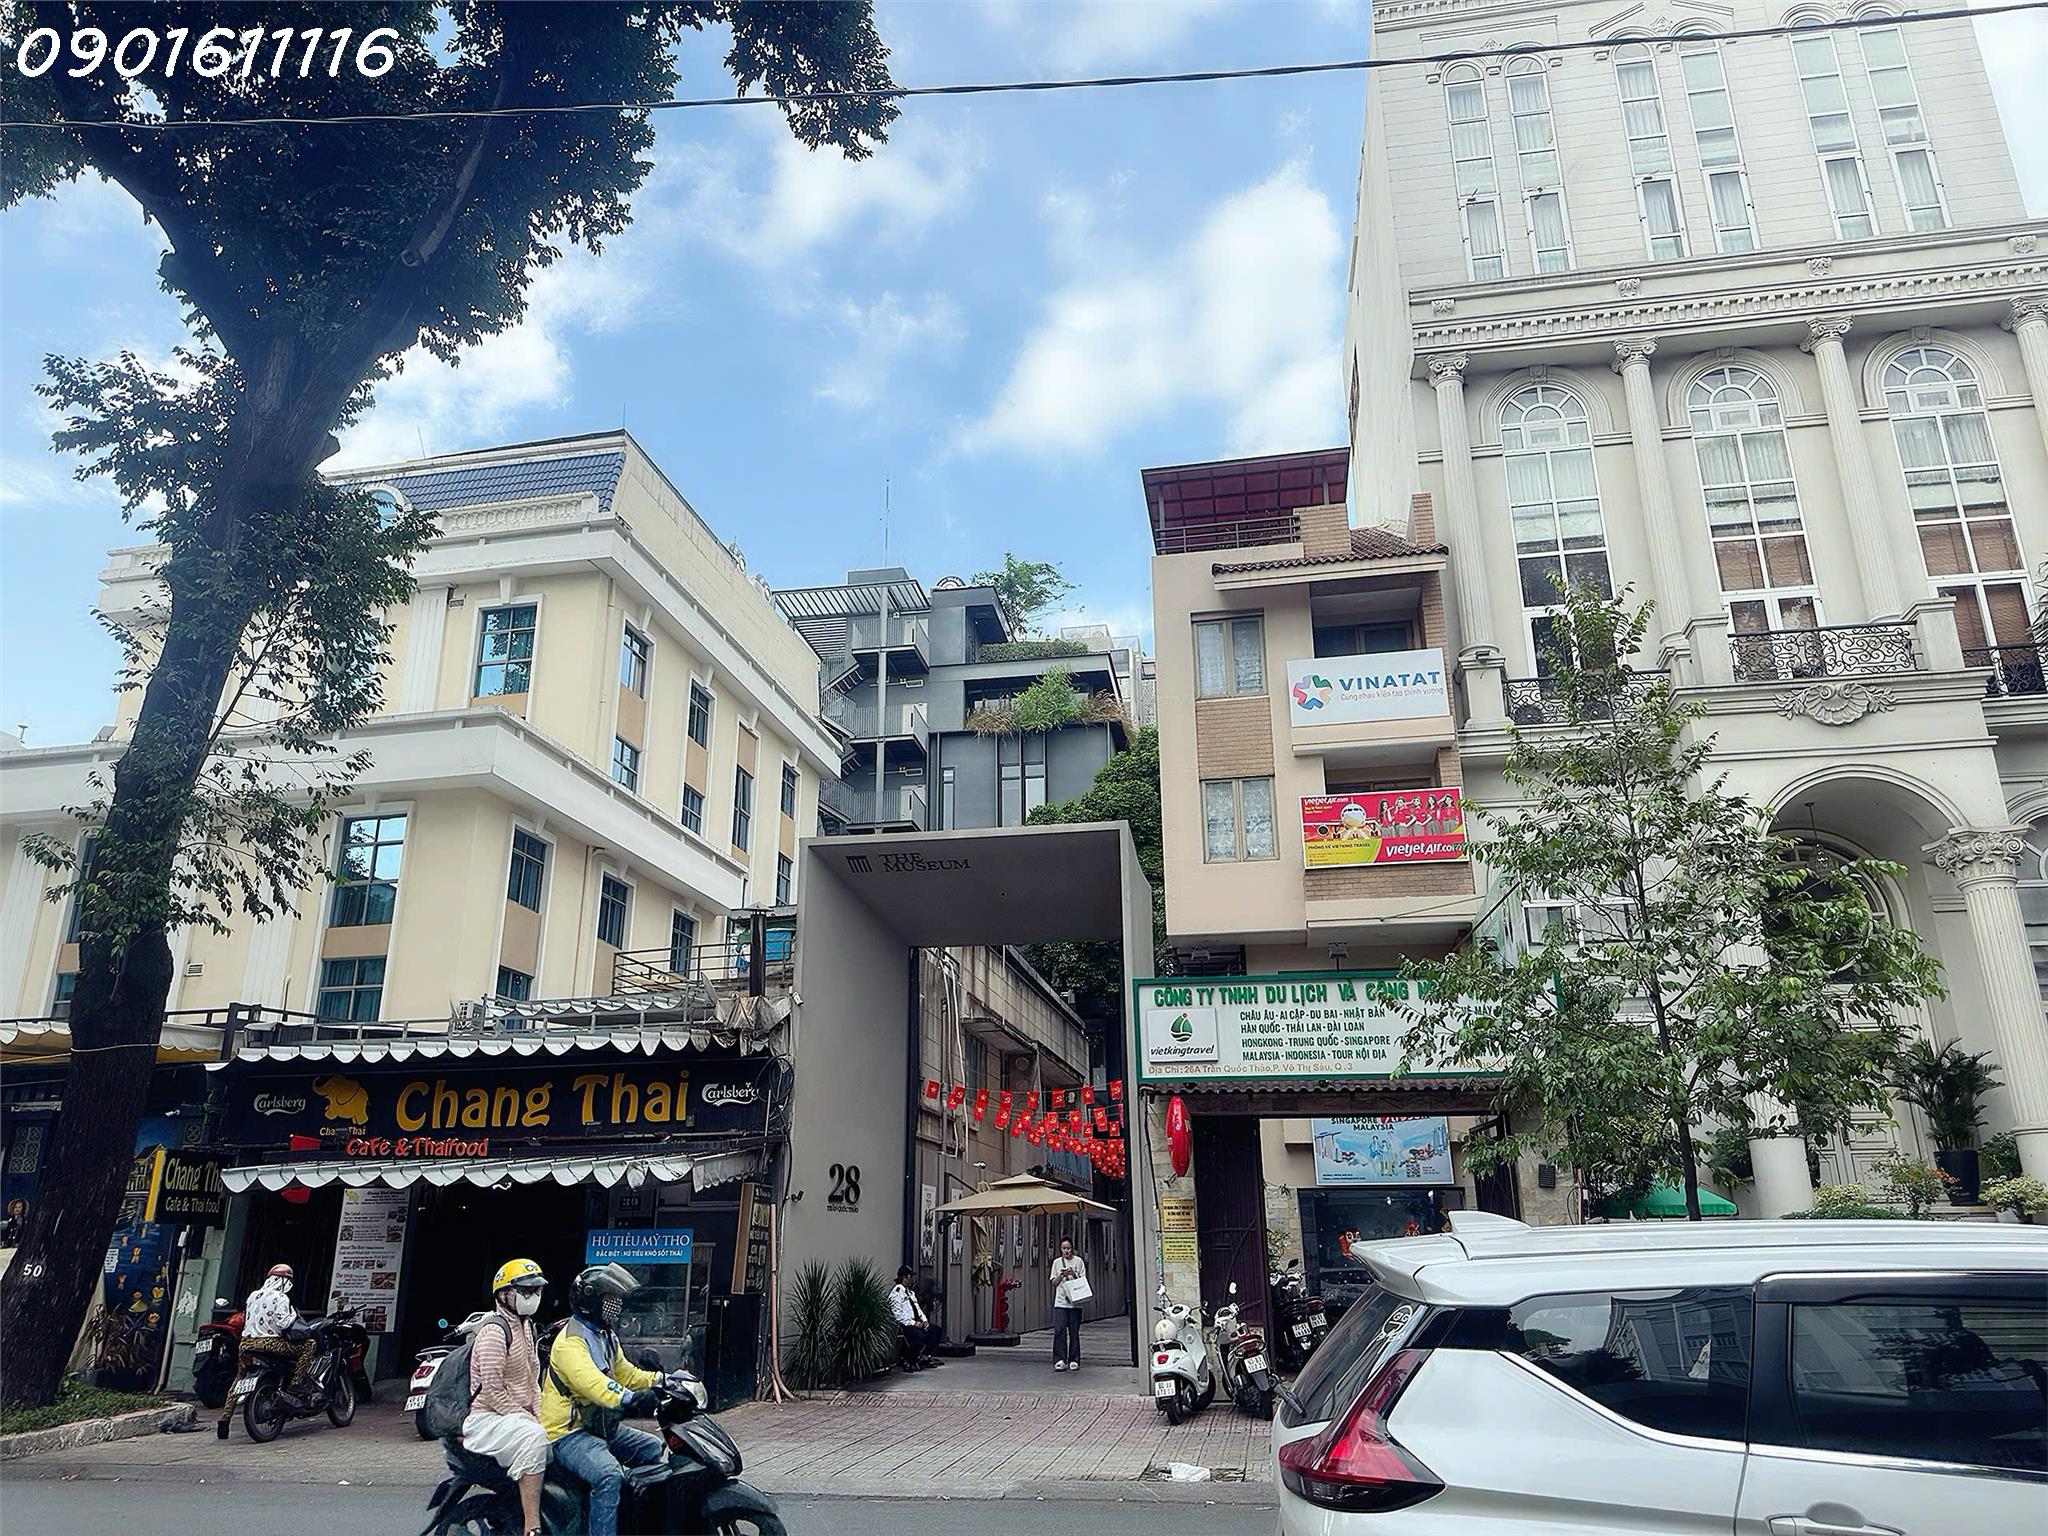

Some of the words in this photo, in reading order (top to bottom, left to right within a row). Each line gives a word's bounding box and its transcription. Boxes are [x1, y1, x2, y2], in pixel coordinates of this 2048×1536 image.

[1338, 671, 1440, 691] VINATAT
[1340, 692, 1358, 701] Cùng
[878, 852, 922, 864] THE
[884, 858, 971, 873] MUSEUM
[1153, 986, 1193, 1007] CÔNG
[1197, 987, 1215, 1006] TY
[1219, 986, 1259, 1005] TNHH
[1265, 985, 1287, 1004] DU
[1292, 984, 1328, 1008] LỊCH
[1337, 978, 1358, 1002] VÀ
[1240, 1009, 1261, 1021] CHÂU
[1264, 1009, 1275, 1020] ÂU
[1280, 1010, 1288, 1020] AI
[1289, 1009, 1305, 1021] CẬP
[1310, 1010, 1321, 1019] DU
[1324, 1009, 1337, 1019] BAI
[1343, 1008, 1365, 1020] NHẬT
[1368, 1006, 1386, 1018] BẢN
[1241, 1022, 1257, 1034] HÀN
[1258, 1020, 1281, 1034] QUỐC
[1286, 1021, 1304, 1033] THÁI
[1307, 1022, 1322, 1033] LAN
[1327, 1020, 1341, 1032] ĐÀI
[1344, 1021, 1365, 1031] LOAN
[1242, 1037, 1283, 1048] HONGKONG
[1316, 1033, 1339, 1046] QUỐC
[1150, 1045, 1215, 1058] vietkingtravel
[1243, 1051, 1280, 1061] MALAYSIA
[1285, 1050, 1326, 1060] INDONESIA
[1332, 1049, 1353, 1059] TOUR
[1356, 1048, 1370, 1060] NỘI
[1372, 1049, 1387, 1060] ĐỊA
[1148, 1065, 1163, 1075] Địa
[1184, 1065, 1201, 1074] 26A
[1202, 1064, 1222, 1073] Trần
[1224, 1062, 1247, 1073] Quốc
[396, 1079, 554, 1132] Chang
[573, 1070, 690, 1126] Thai
[701, 1082, 760, 1106] Carlsberg
[254, 1093, 306, 1115] Carlsberg
[1331, 1117, 1378, 1125] SINGAPORE
[1353, 1123, 1394, 1131] MALAYSIA
[320, 1126, 342, 1137] Cha
[165, 1158, 203, 1191] Chang
[828, 1163, 861, 1205] 28
[592, 1232, 611, 1247] HỦ
[641, 1232, 661, 1247] MỸ
[662, 1234, 690, 1246] THO
[23, 1263, 42, 1278] 50
